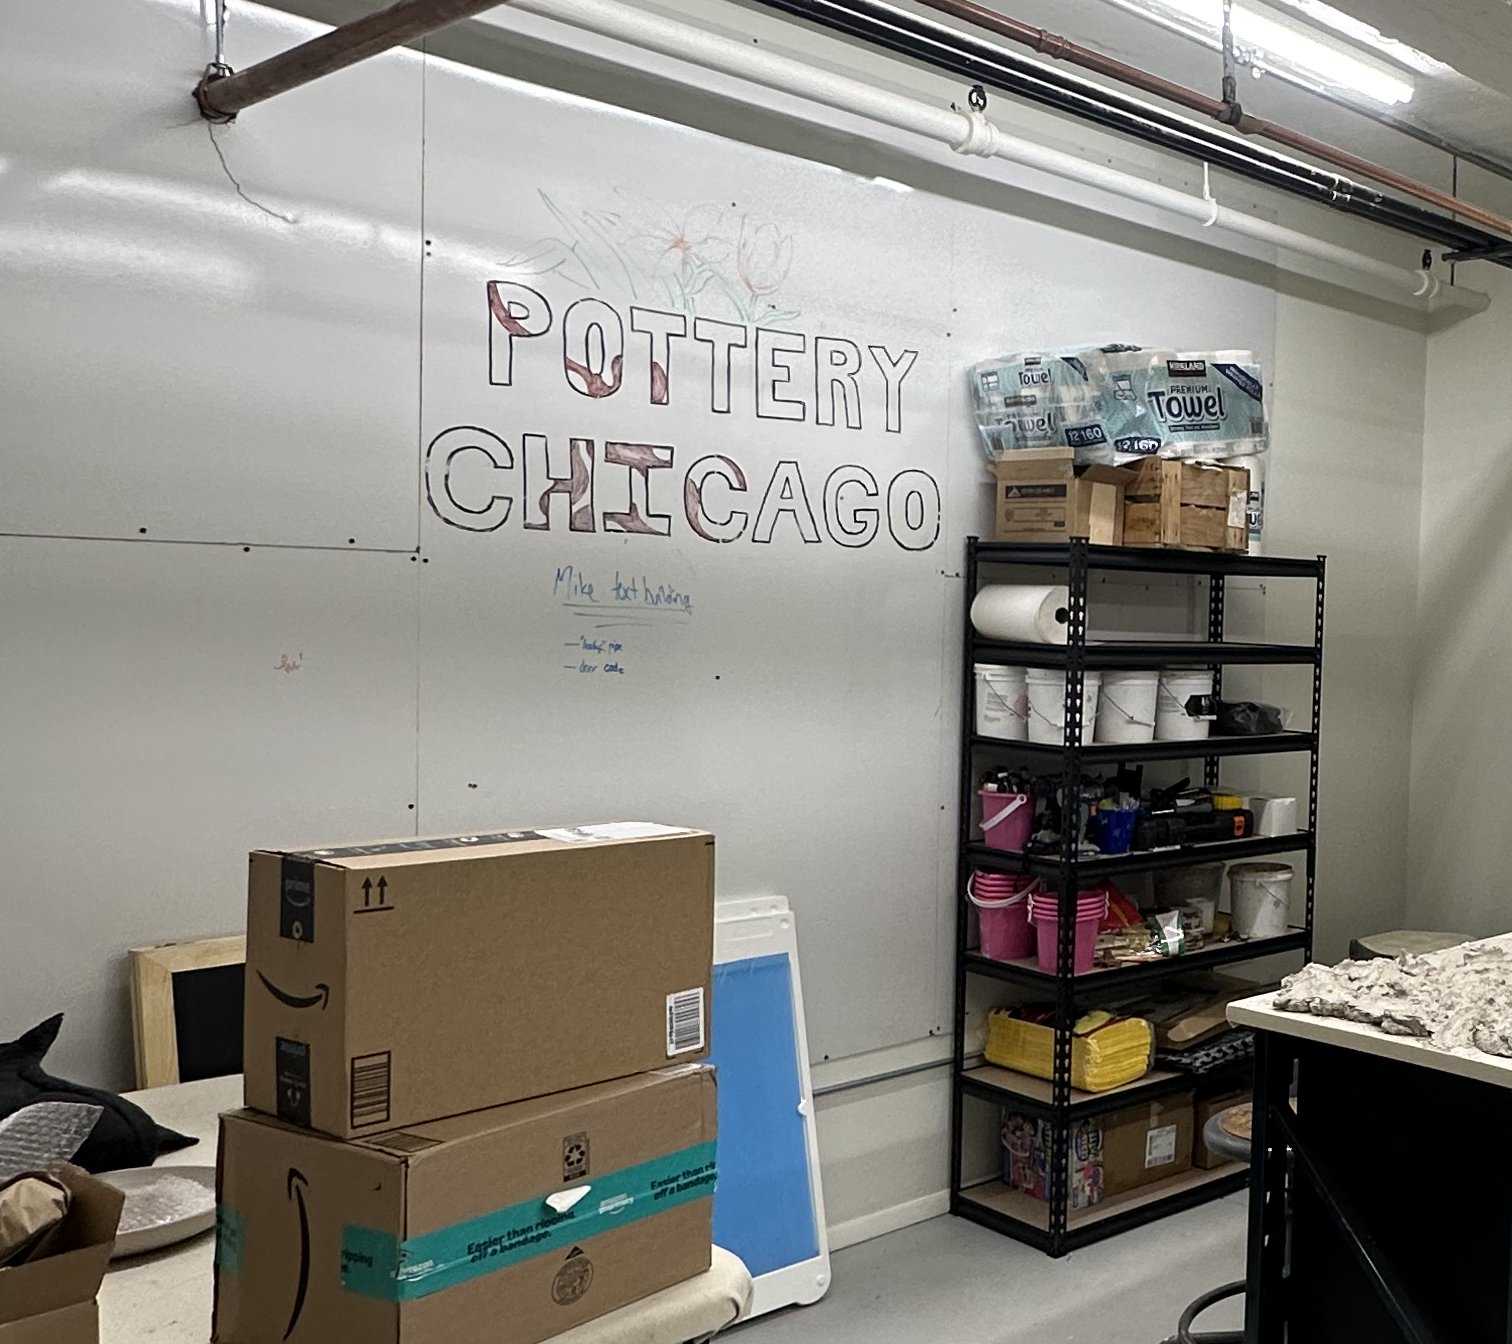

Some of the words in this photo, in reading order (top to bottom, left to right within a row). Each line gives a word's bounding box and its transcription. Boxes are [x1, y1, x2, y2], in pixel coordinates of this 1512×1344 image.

[486, 280, 919, 434] POTTERY
[1018, 368, 1053, 385] Towel
[1170, 384, 1209, 394] PREMIUM
[1147, 387, 1225, 420] Towel
[424, 425, 941, 551] CHICAGO
[553, 565, 600, 603] Mike
[611, 570, 638, 601] text
[467, 1235, 505, 1255] Easier
[506, 1225, 534, 1240] than
